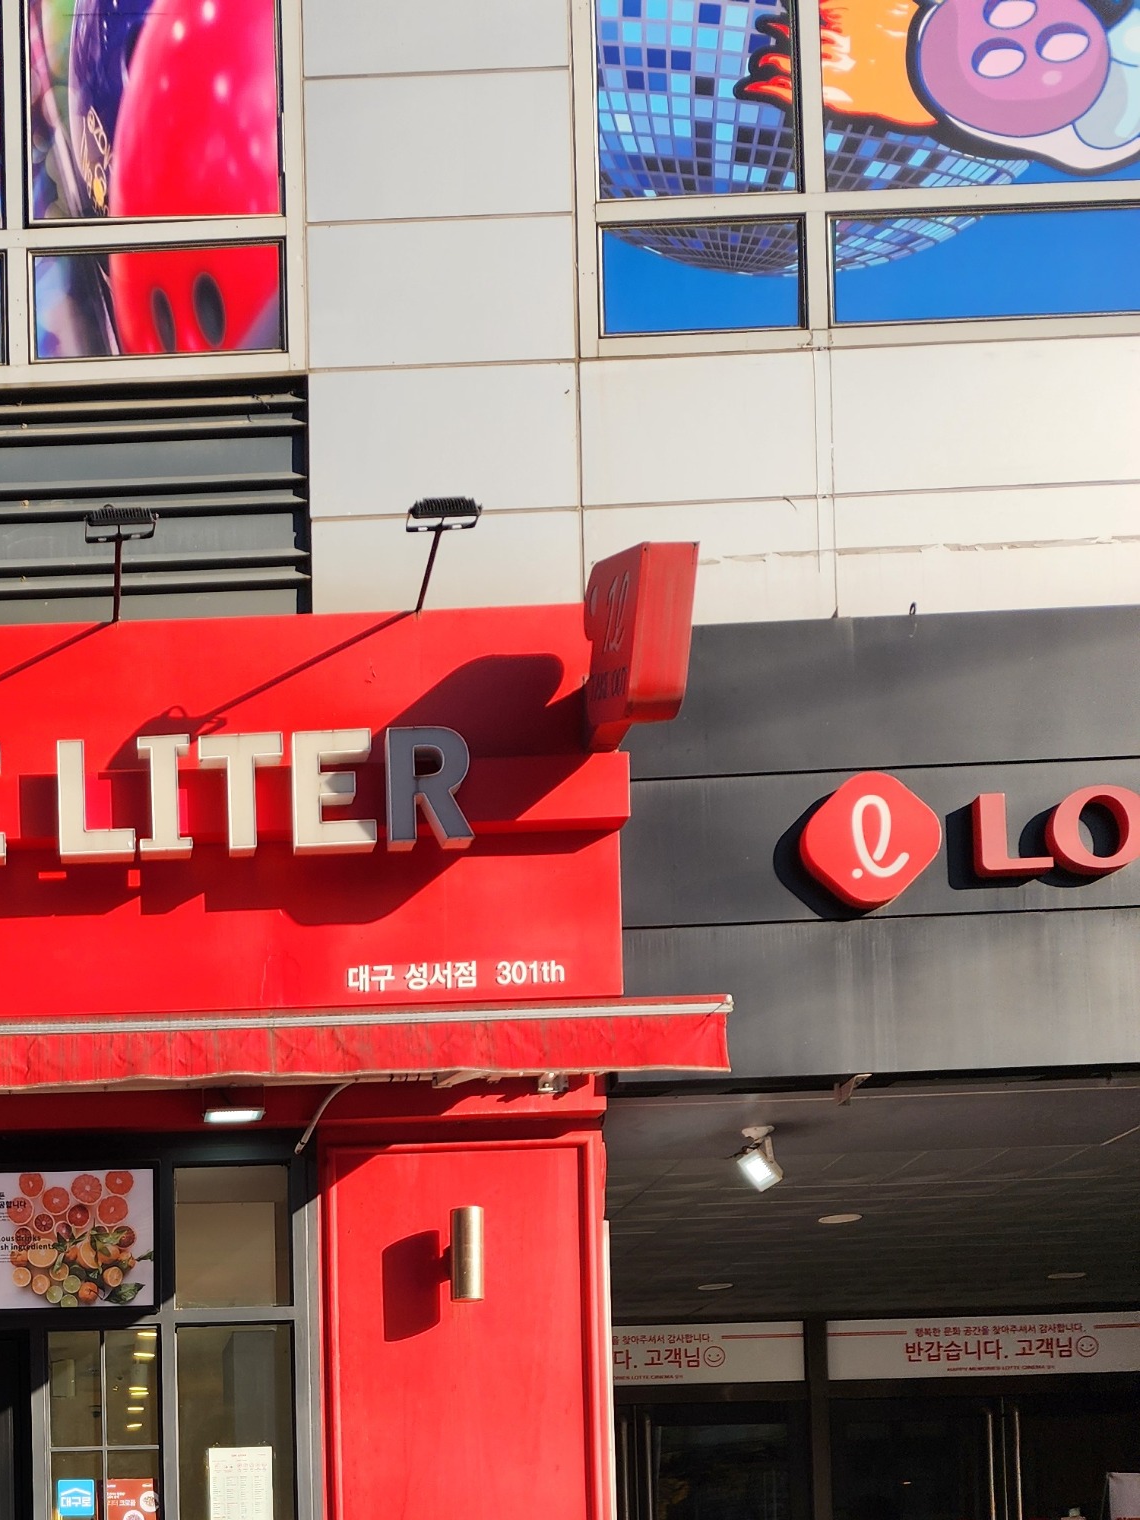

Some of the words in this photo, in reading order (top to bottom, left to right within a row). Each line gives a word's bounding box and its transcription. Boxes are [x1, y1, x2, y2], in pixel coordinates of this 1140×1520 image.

[57, 725, 475, 863] LITER
[347, 965, 395, 992] 대구
[405, 961, 477, 990] 성서점
[496, 960, 565, 985] 301th
[16, 1234, 41, 1242] drinks
[10, 1243, 55, 1252] ingredients
[915, 1327, 941, 1337] 행복한
[963, 1325, 990, 1335] 공간을
[992, 1324, 1037, 1335] 찾아주셔서
[623, 1334, 665, 1344] 찾아주셔서
[905, 1339, 1008, 1362] 반갑습니다.
[1015, 1337, 1073, 1359] 고객님
[644, 1347, 701, 1368] 고객님
[61, 1496, 92, 1508] 대구로
